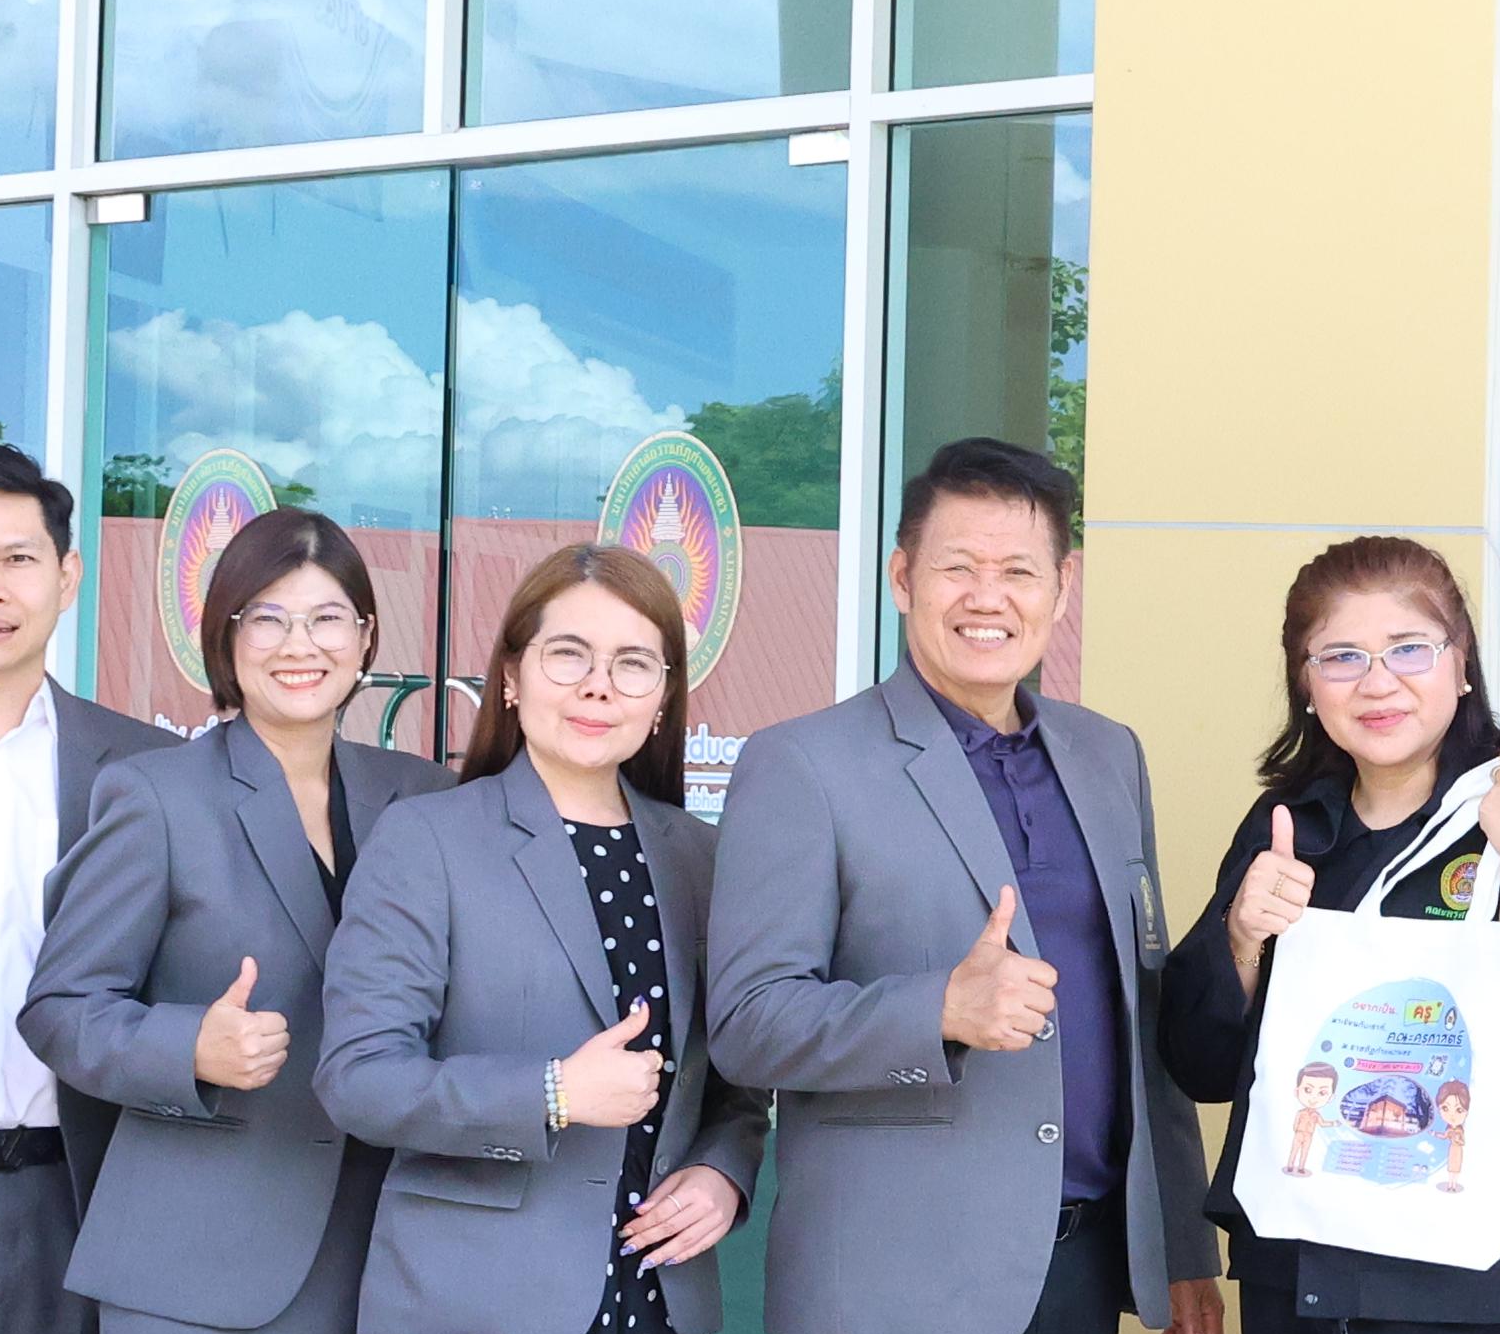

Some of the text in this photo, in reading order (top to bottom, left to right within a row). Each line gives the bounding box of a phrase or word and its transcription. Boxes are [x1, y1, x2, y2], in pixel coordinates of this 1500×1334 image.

[1413, 1004, 1432, 1025] ครู
[1385, 1030, 1465, 1047] คณะครุศาสตร์
